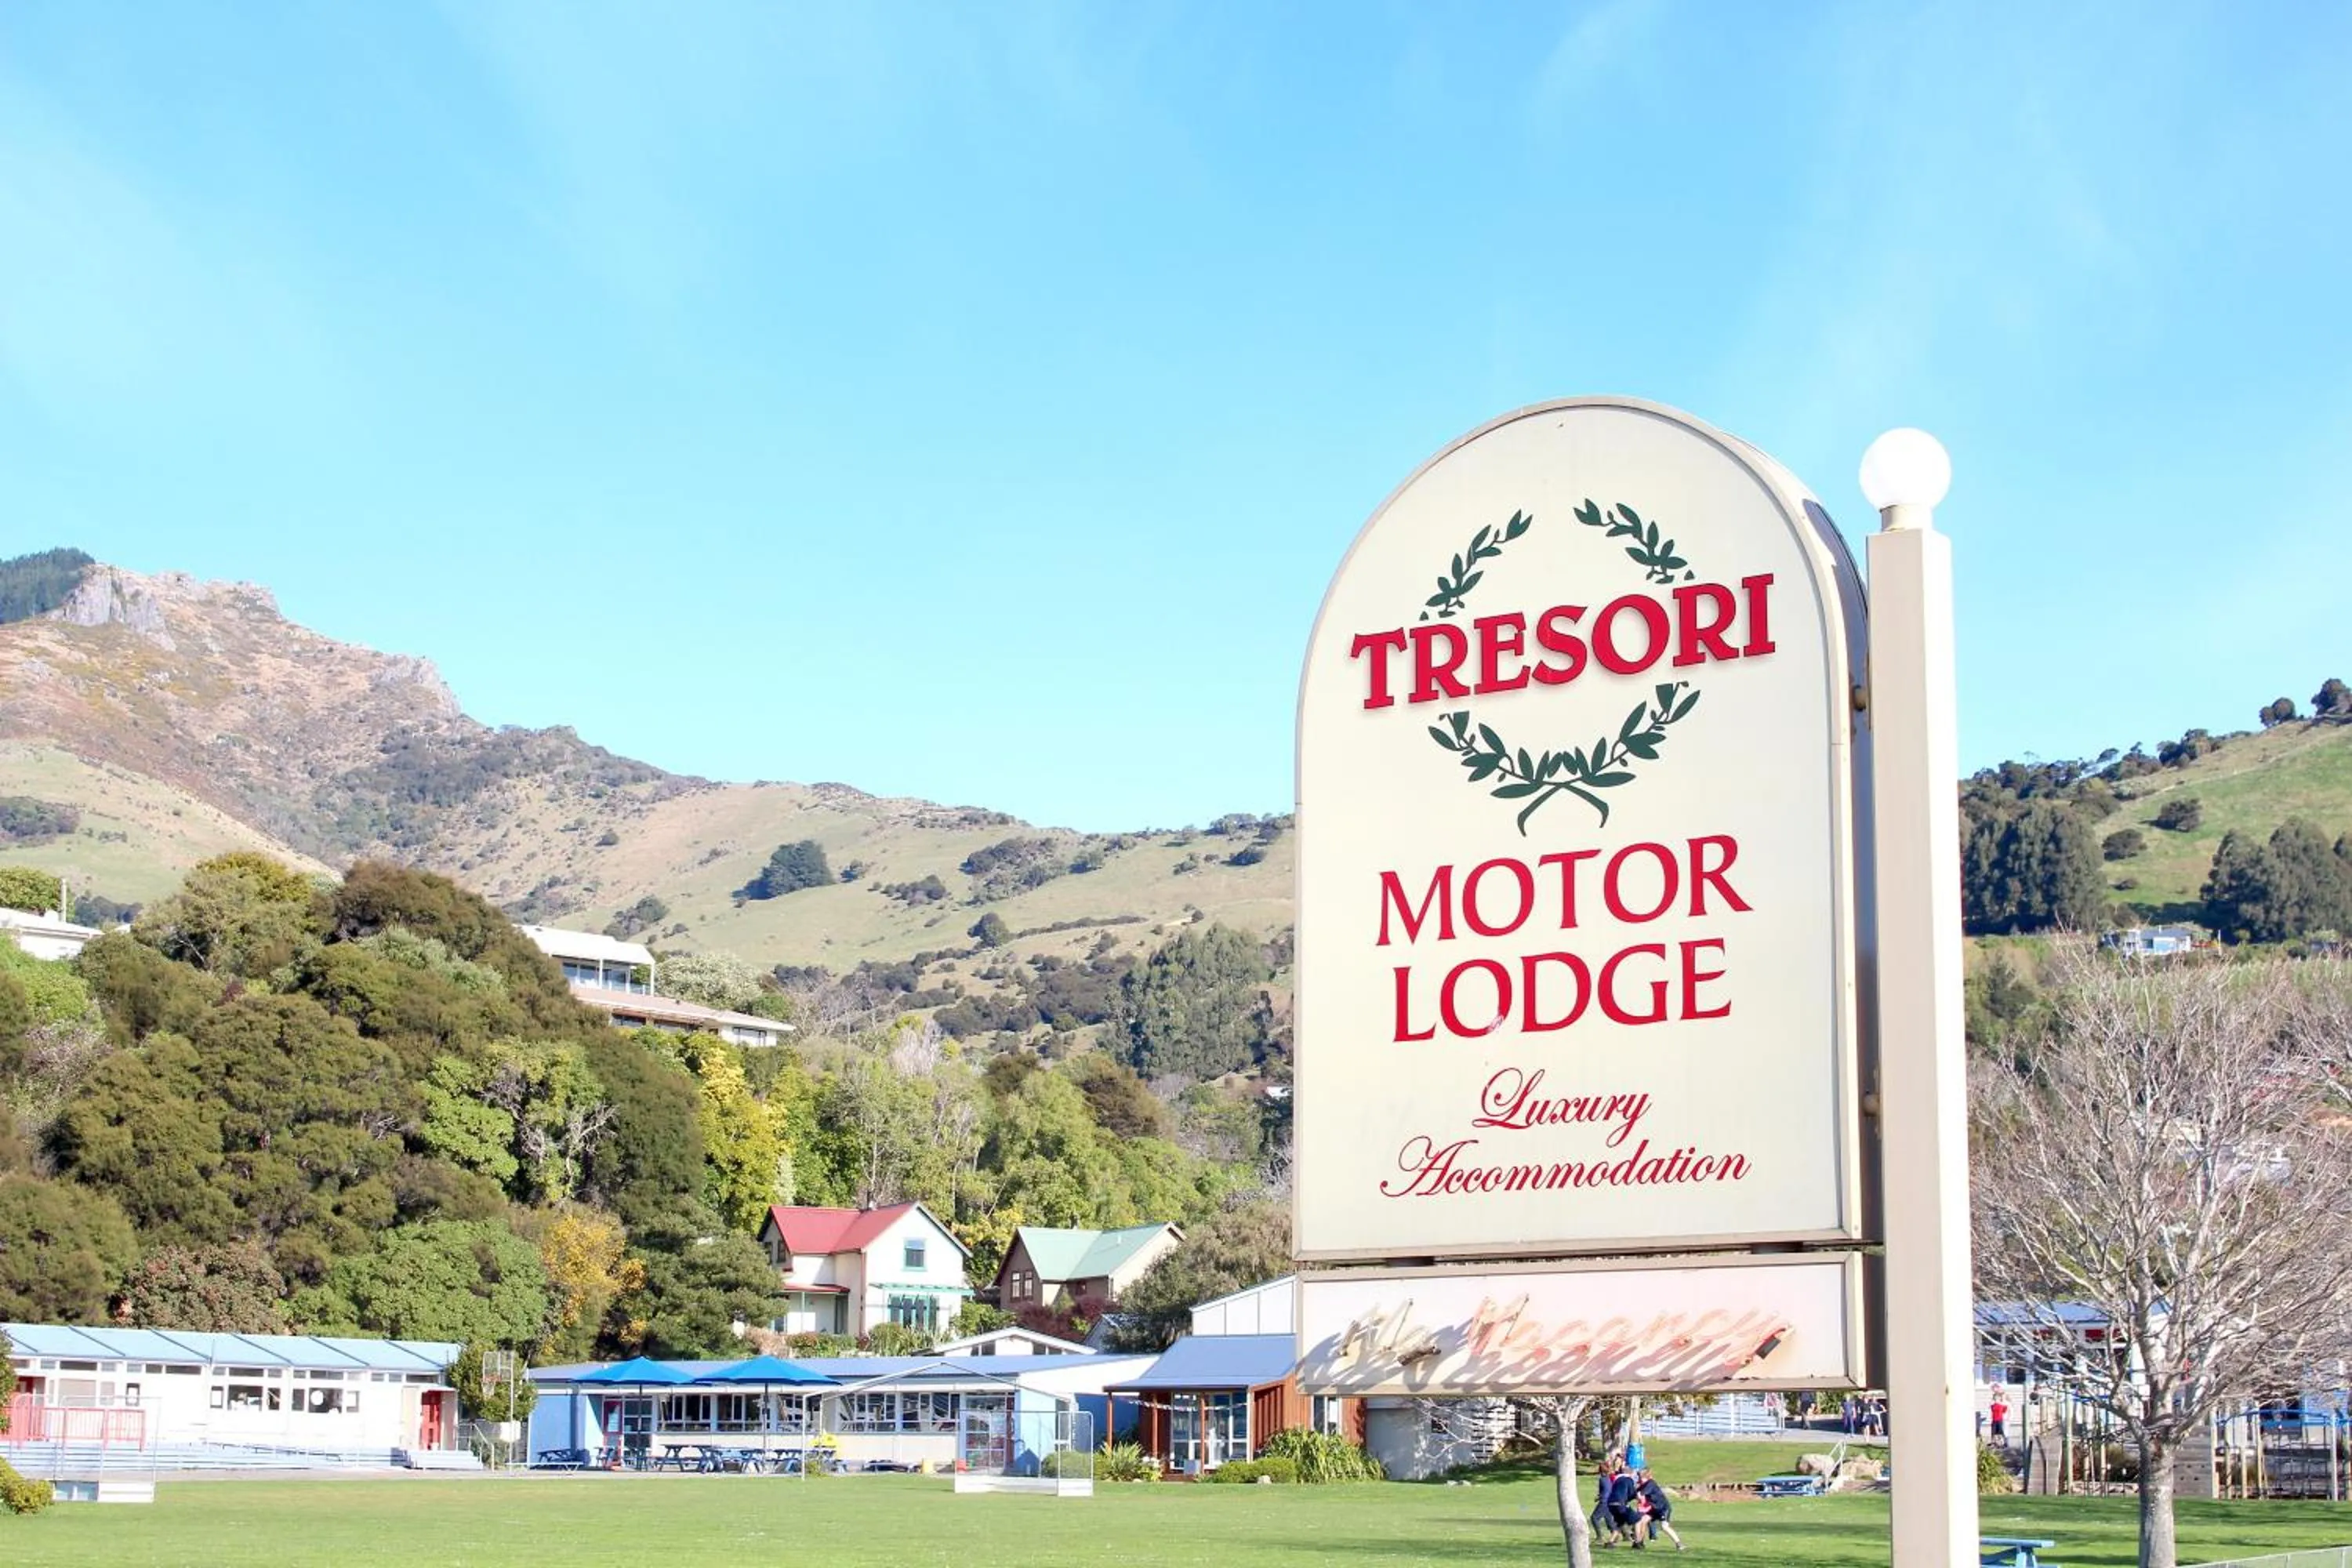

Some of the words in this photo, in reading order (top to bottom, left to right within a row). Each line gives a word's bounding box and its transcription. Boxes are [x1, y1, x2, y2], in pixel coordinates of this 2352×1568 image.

[1348, 573, 1777, 712] TRESORI
[1375, 833, 1754, 947] MOTOR
[1392, 937, 1733, 1044] LODGE
[1472, 1068, 1652, 1148] Luxury
[1378, 1136, 1752, 1198] Accommodation
